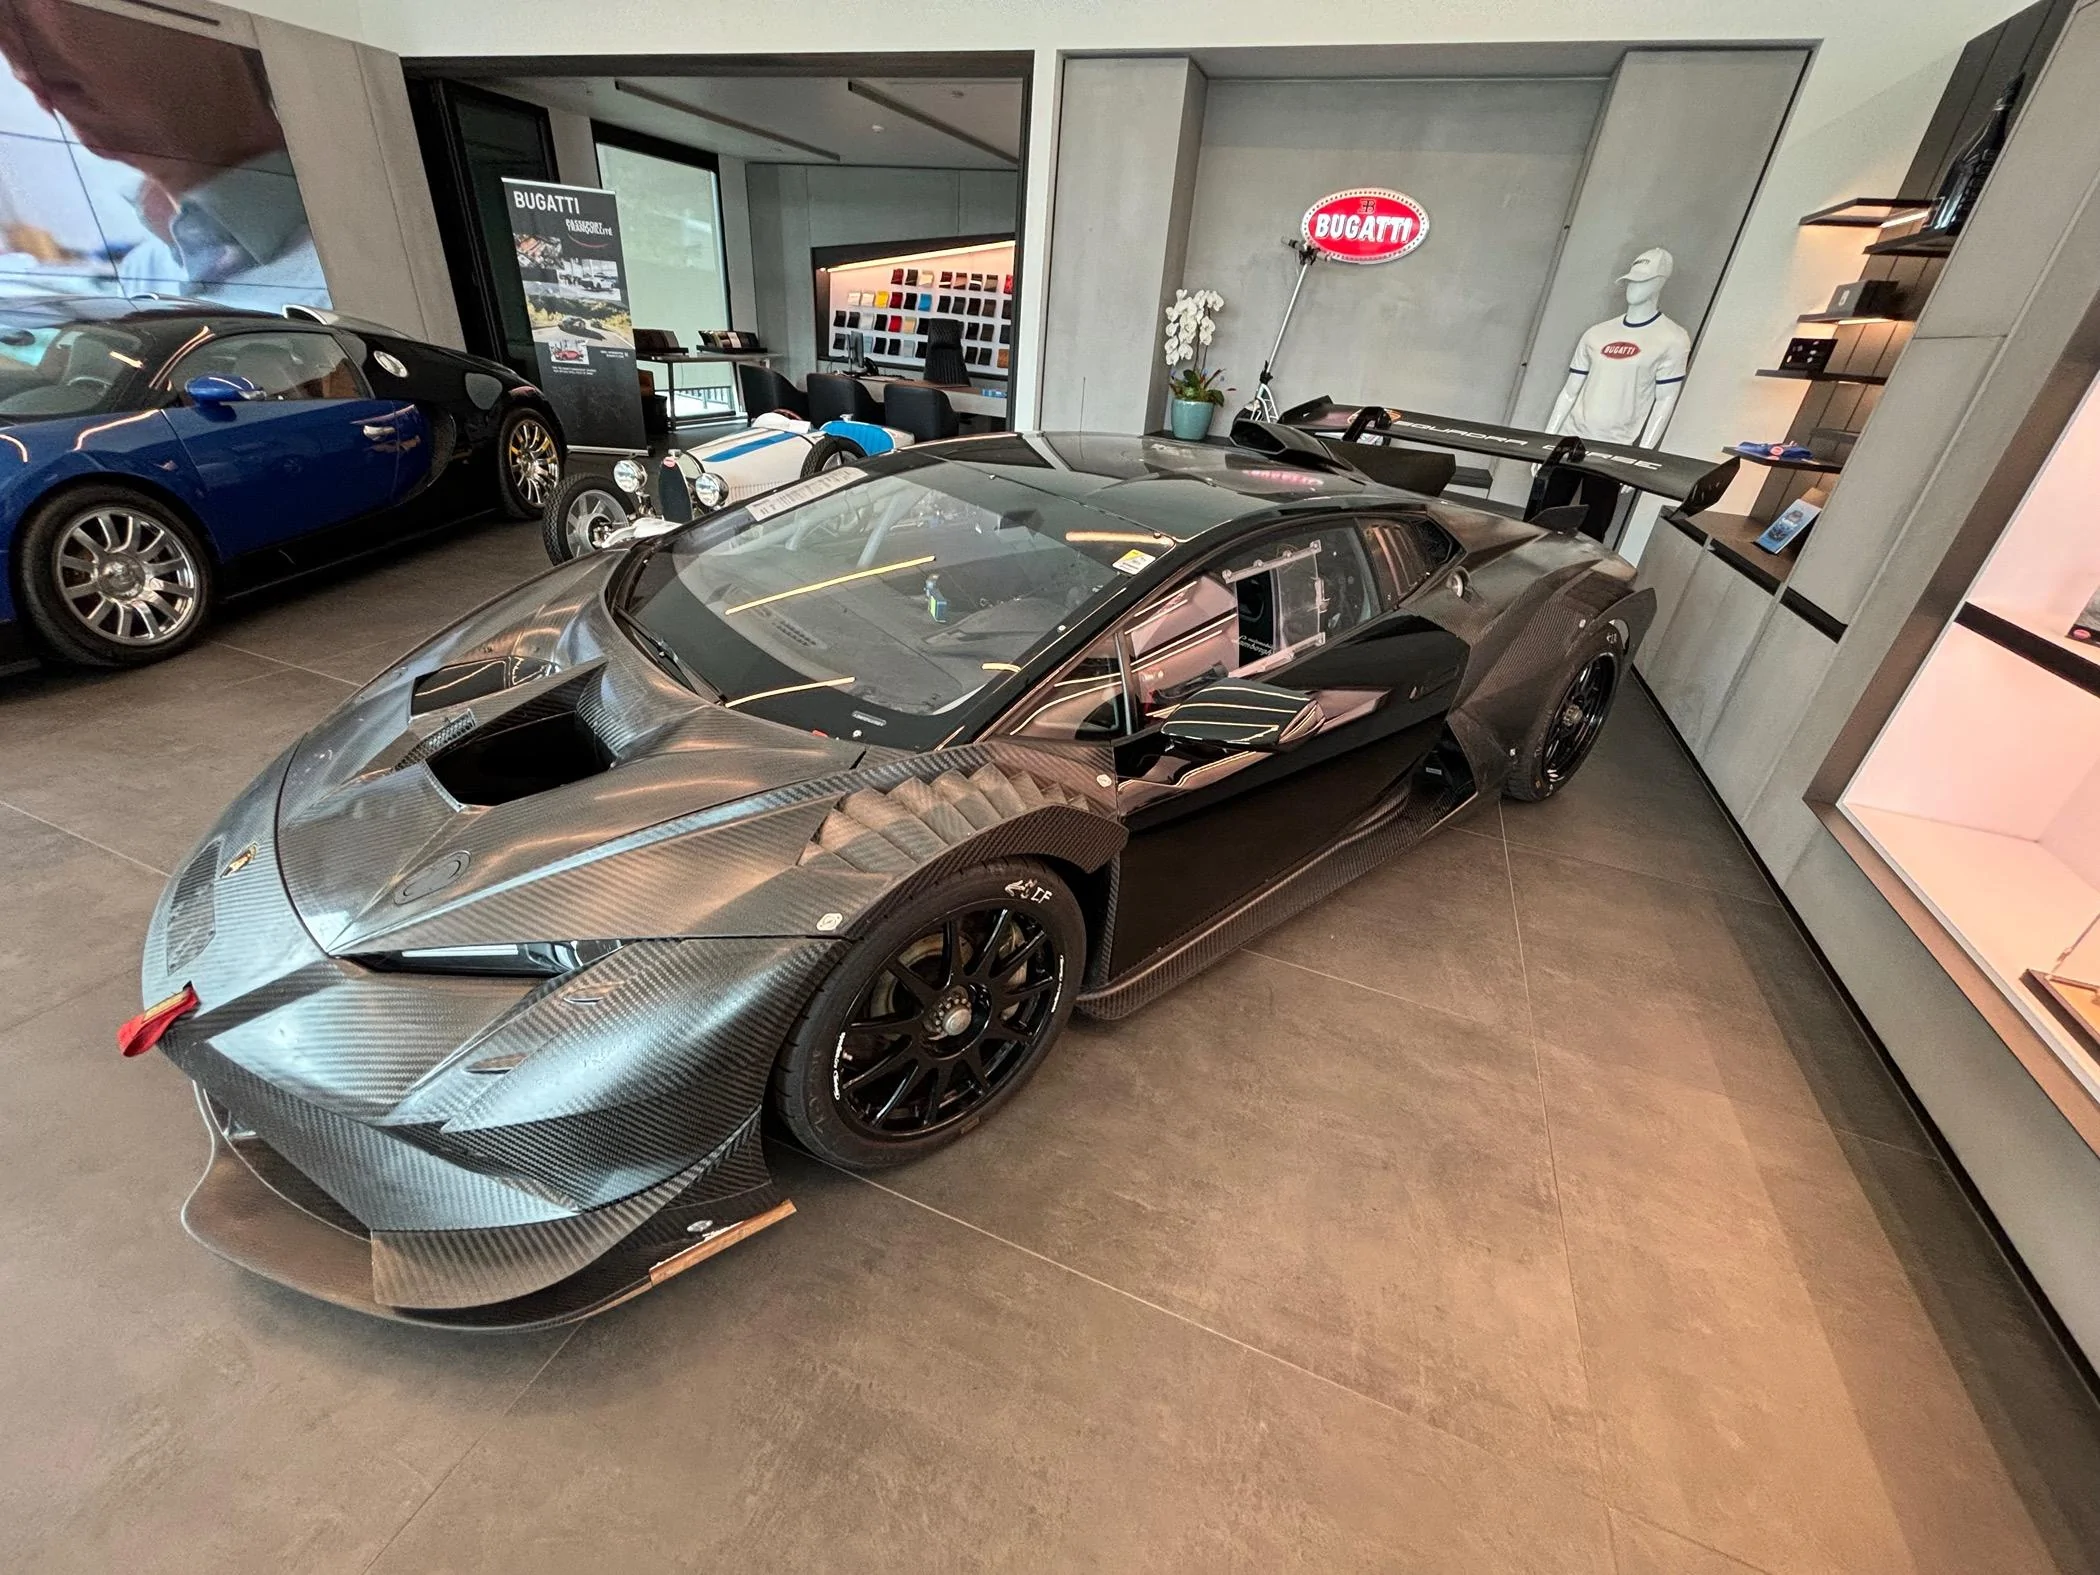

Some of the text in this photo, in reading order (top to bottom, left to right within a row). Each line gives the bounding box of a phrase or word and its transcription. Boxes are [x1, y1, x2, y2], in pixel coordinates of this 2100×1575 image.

[513, 190, 580, 215] BUGATTI
[1315, 213, 1413, 243] BUGATTI
[1604, 345, 1636, 355] BUGATTI
[1542, 444, 1663, 470] CRSE
